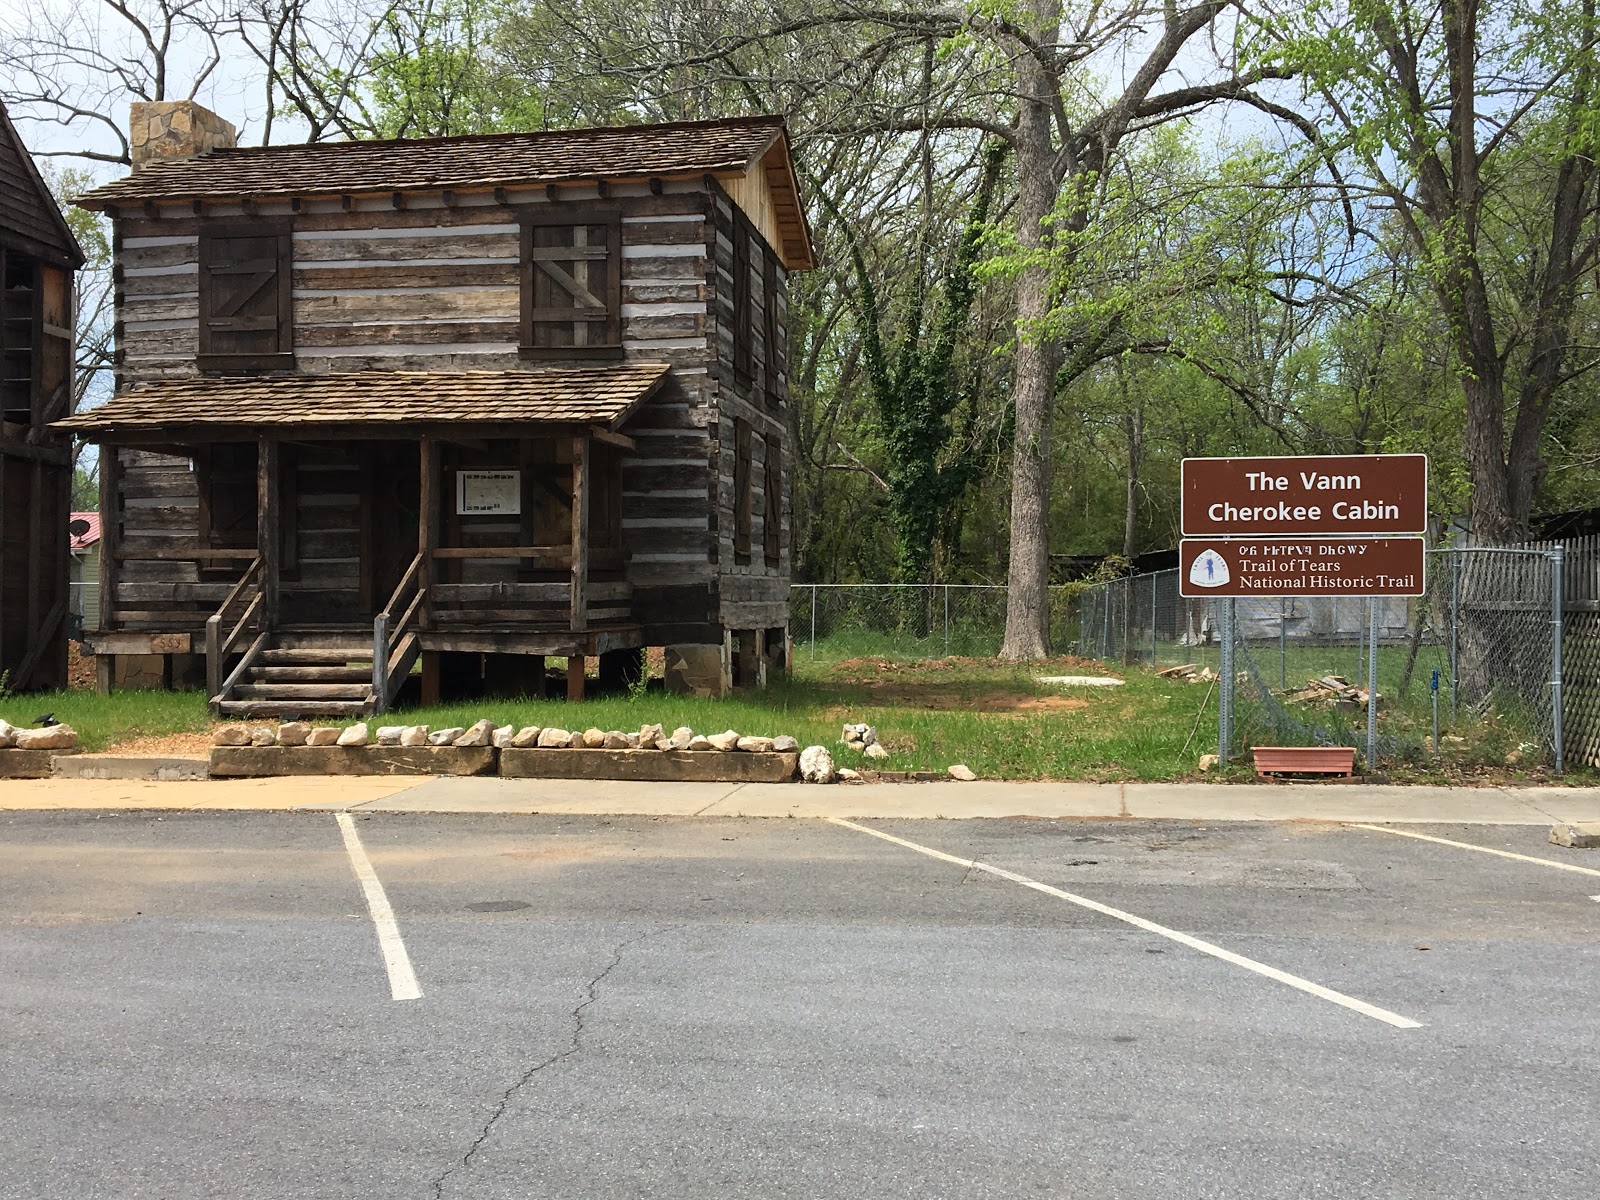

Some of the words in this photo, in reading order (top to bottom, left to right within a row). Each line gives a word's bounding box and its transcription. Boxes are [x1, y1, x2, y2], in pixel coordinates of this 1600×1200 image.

[1245, 471, 1289, 491] The
[1299, 471, 1361, 490] Vann
[1208, 501, 1322, 522] Cherokee
[1332, 499, 1399, 520] Cabin
[1239, 559, 1277, 572] Trail
[1279, 559, 1297, 572] of
[1297, 559, 1341, 572] Tears
[1239, 575, 1306, 589] National
[1309, 575, 1374, 588] Historic
[1375, 574, 1415, 588] Trail
